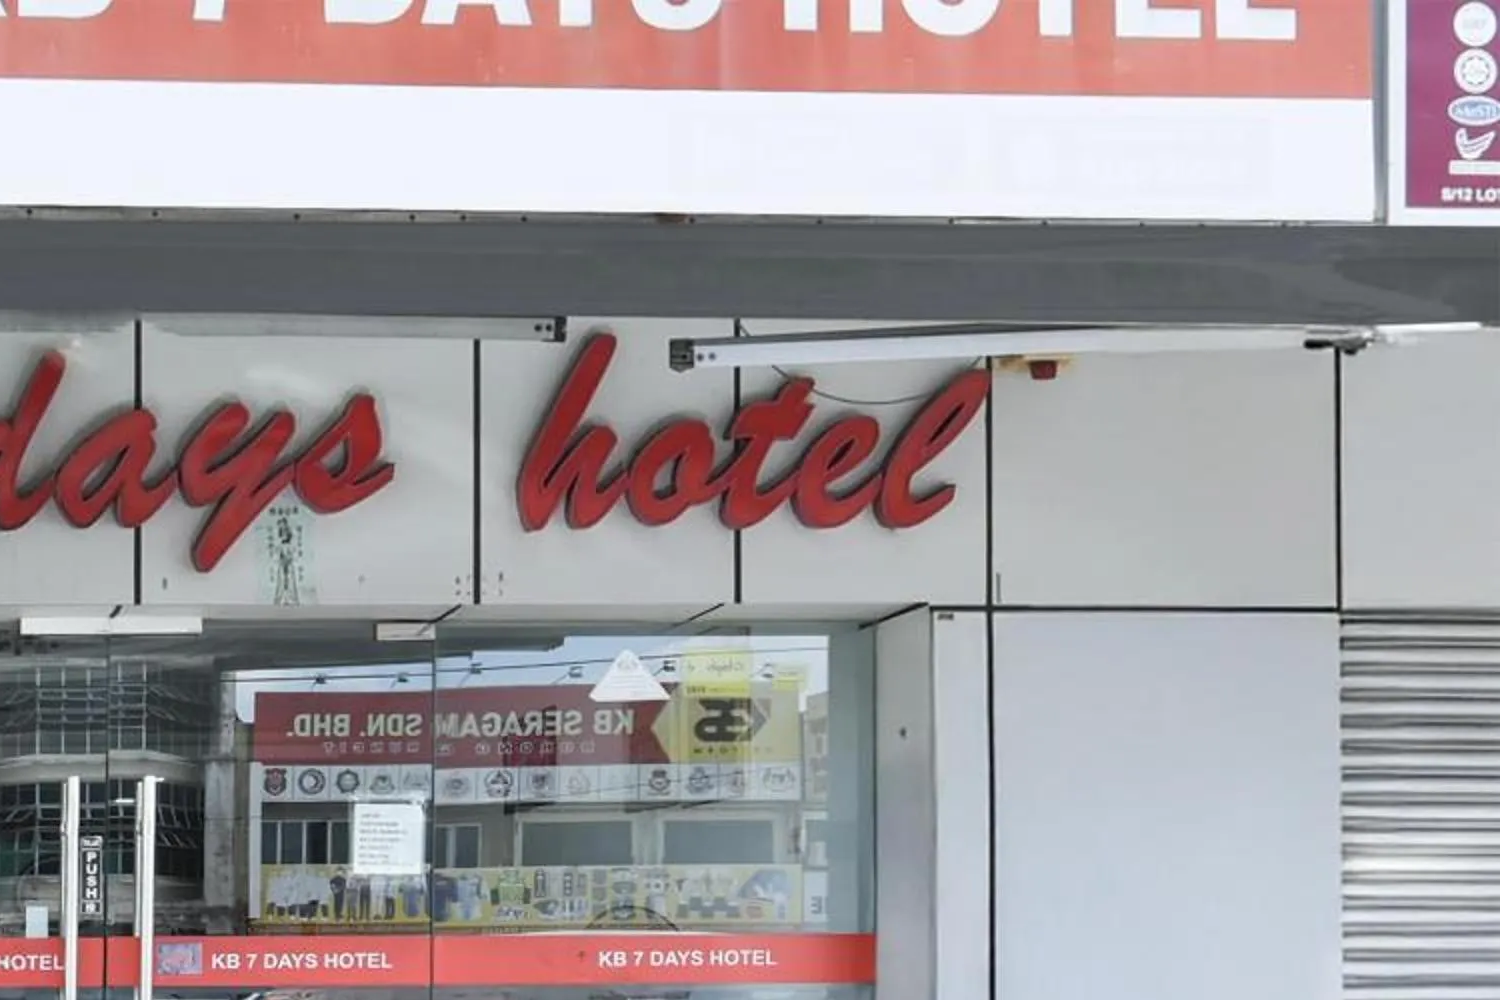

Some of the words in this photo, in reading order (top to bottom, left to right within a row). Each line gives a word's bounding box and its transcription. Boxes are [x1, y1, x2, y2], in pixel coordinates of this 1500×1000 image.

[1475, 187, 1500, 202] LO
[516, 330, 992, 532] hotel
[85, 851, 98, 899] PUSH
[211, 953, 241, 969] KB
[246, 953, 258, 969] 7
[263, 953, 319, 969] DAYS
[324, 952, 393, 969] HOTEL
[598, 951, 627, 968] KB
[633, 951, 644, 967] 7
[650, 951, 704, 967] DAYS
[709, 949, 778, 966] HOTEL
